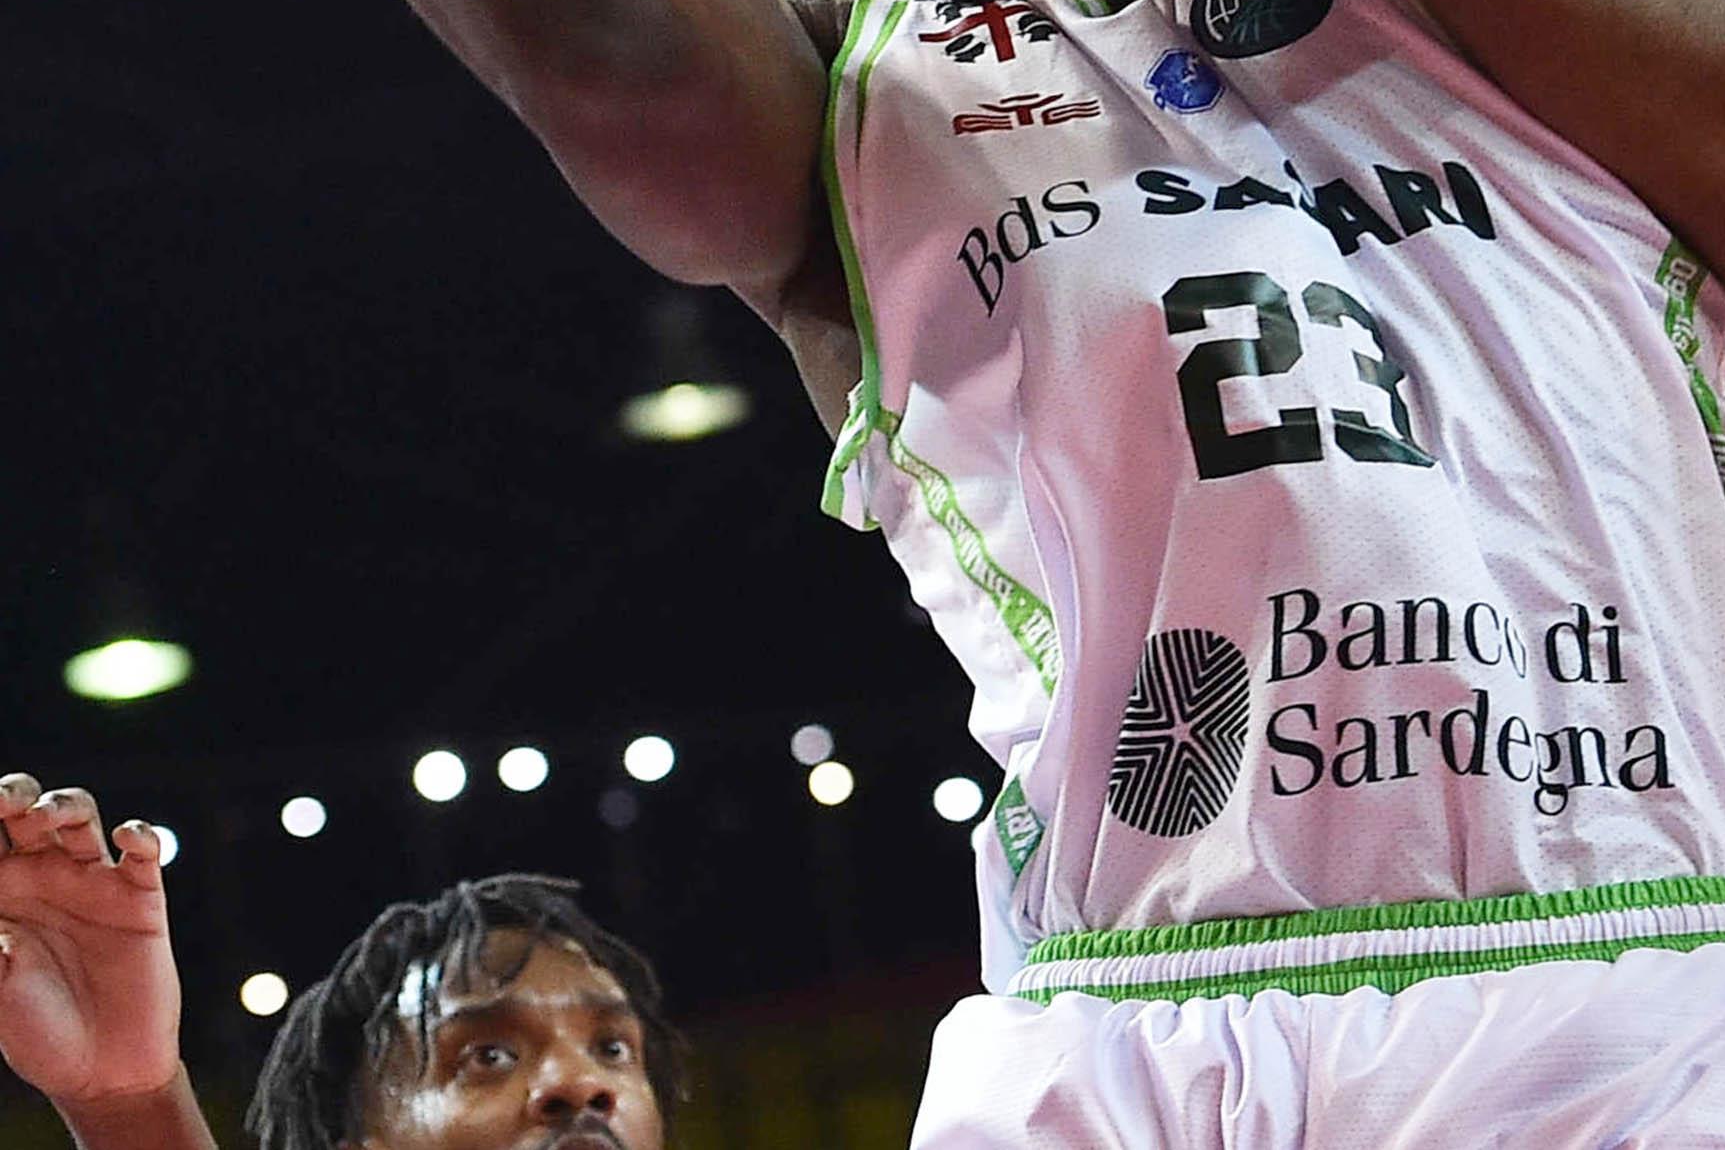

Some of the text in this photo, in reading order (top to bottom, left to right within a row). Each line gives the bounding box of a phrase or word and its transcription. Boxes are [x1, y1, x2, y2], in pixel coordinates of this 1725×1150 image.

[956, 180, 1102, 318] BdS
[1161, 270, 1440, 481] 23
[1266, 587, 1629, 684] Banco di
[1266, 687, 1676, 817] Sardegna
